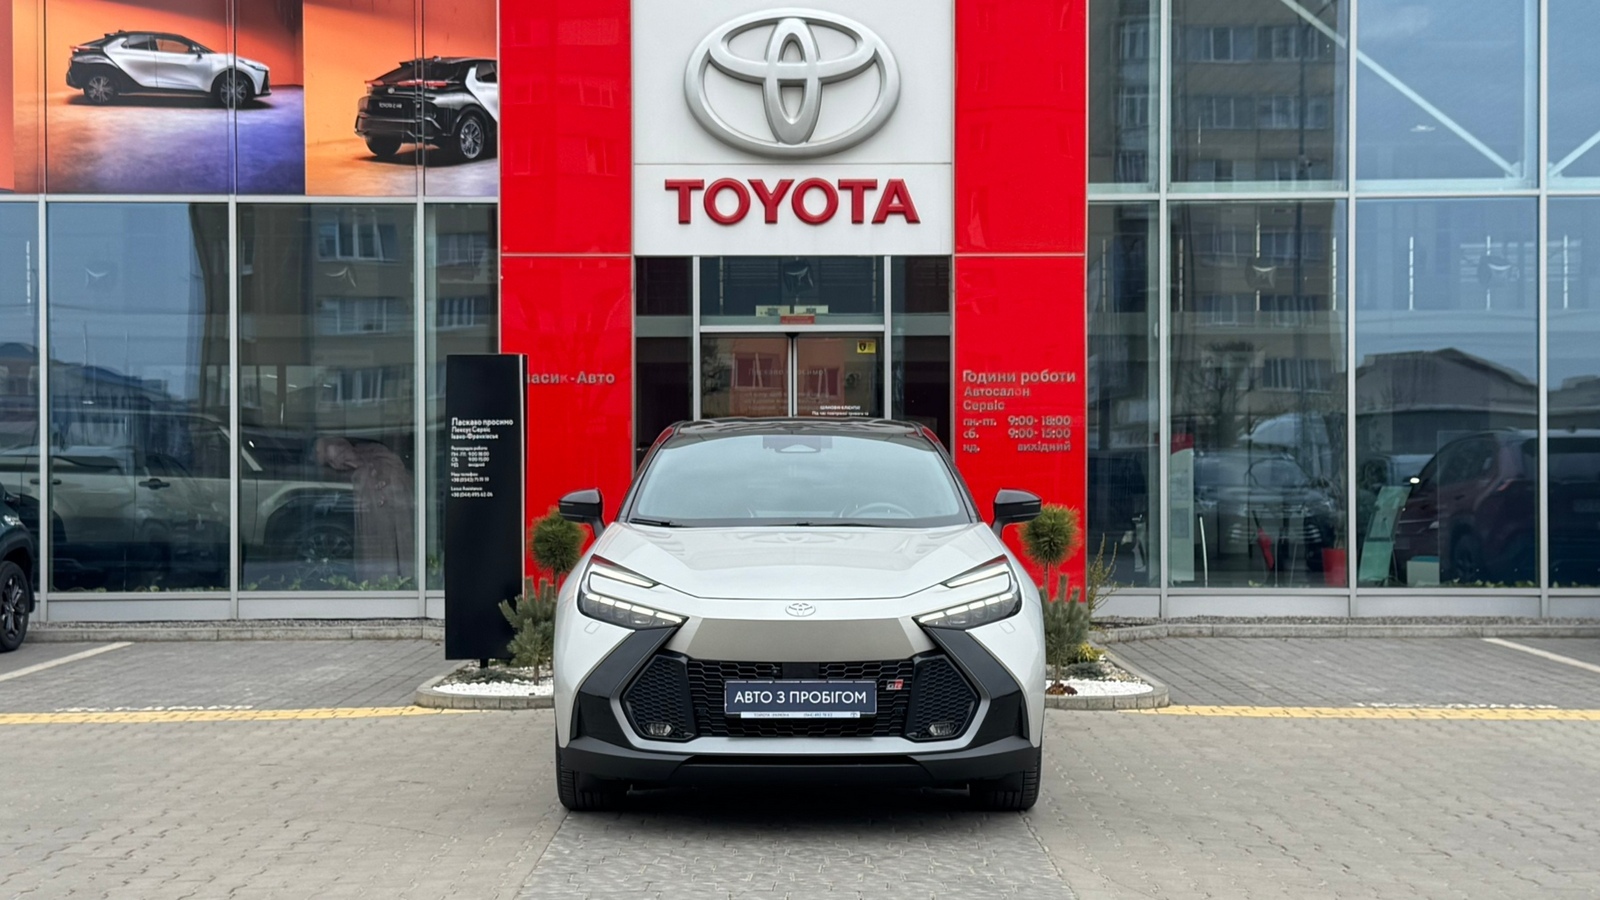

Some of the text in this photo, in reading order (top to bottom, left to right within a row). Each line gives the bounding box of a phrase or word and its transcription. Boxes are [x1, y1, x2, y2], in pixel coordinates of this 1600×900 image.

[665, 177, 921, 226] TOYOTA
[528, 371, 616, 384] асик-Авто
[963, 369, 1076, 385] Години роботи
[964, 387, 1030, 397] Автосалон
[963, 400, 1005, 412] Сервіс
[451, 417, 514, 427] Ласкаво просимо
[963, 427, 979, 438] сб.
[963, 441, 1071, 453] нд. вихідний
[734, 691, 867, 704] АВТО З ПРОБІГОМ
